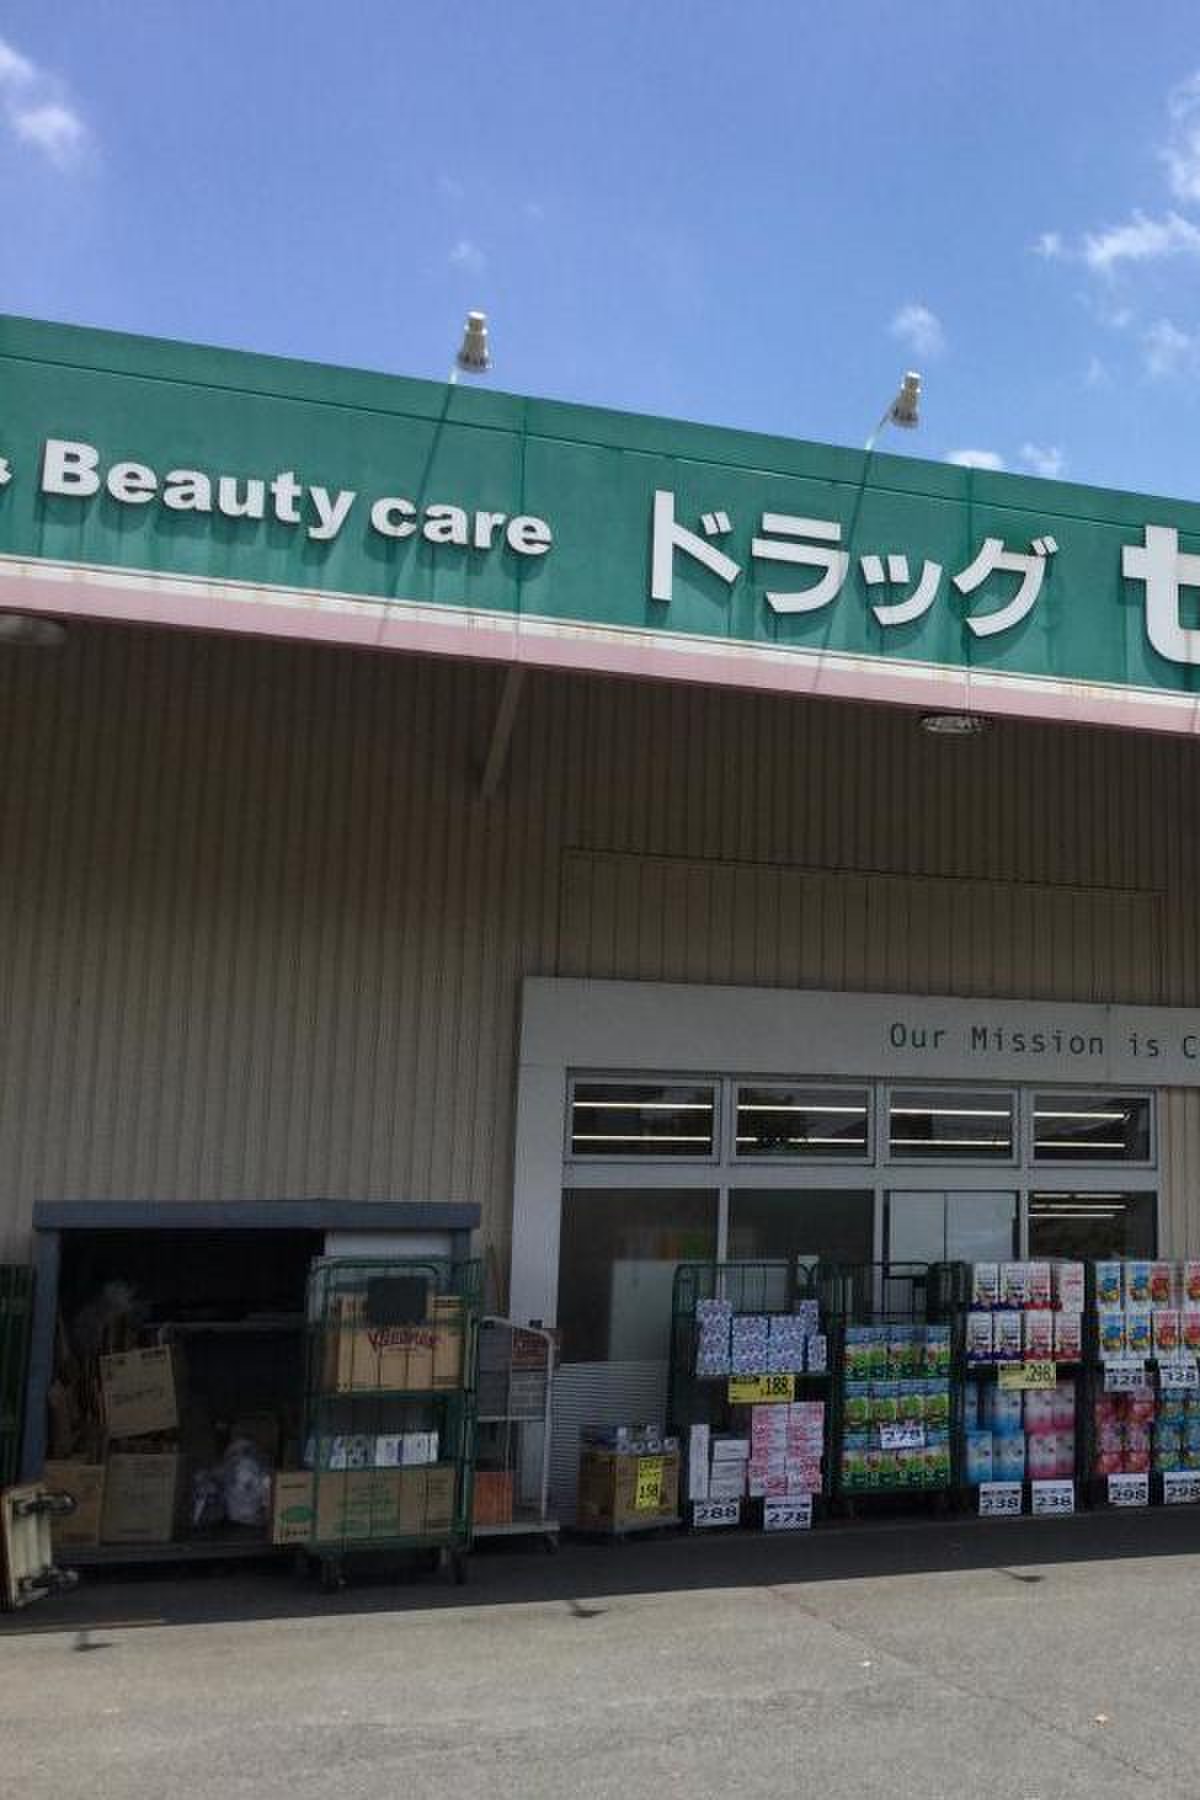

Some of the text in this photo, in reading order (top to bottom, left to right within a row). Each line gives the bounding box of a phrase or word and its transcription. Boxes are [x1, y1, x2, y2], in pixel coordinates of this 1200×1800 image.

[42, 439, 552, 555] Beauty care
[651, 490, 1058, 637] ドラッグ
[890, 1023, 945, 1048] Our
[971, 1026, 1104, 1054] Mission
[1129, 1036, 1159, 1058] is
[697, 1506, 738, 1519] 288
